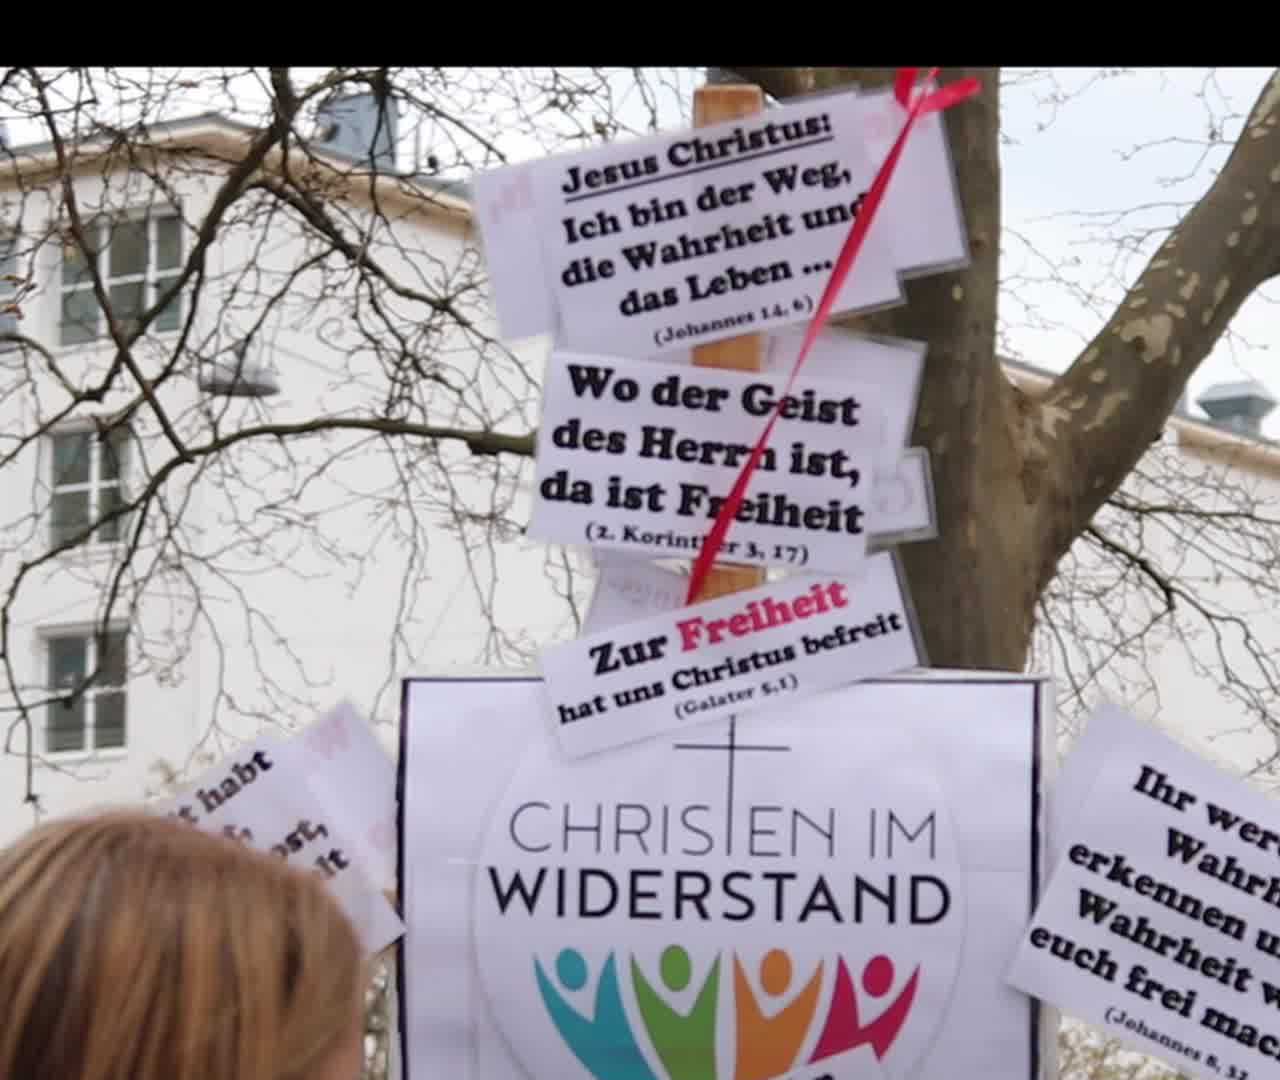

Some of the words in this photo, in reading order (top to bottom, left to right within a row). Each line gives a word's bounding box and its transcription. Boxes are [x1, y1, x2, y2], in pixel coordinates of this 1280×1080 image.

[562, 156, 659, 194] Jesus
[668, 114, 832, 167] Christus:
[563, 212, 621, 243] Ich
[628, 199, 688, 227] bin
[697, 183, 754, 212] der
[763, 162, 851, 194] Weg,
[562, 258, 614, 287] die
[622, 214, 793, 270] Wahrheit
[620, 288, 678, 316] das
[685, 261, 792, 301] Leben
[654, 312, 754, 345] (Johannes
[568, 365, 639, 402] Wo
[652, 376, 729, 412] der
[741, 384, 860, 426] Geist
[552, 419, 626, 454] des
[639, 426, 776, 471] Herrn
[789, 442, 859, 487] ist,
[540, 472, 593, 504] da
[606, 476, 666, 512] ist
[677, 483, 864, 534] Freiheit
[586, 522, 615, 542] (2.
[624, 526, 739, 554] Korintr
[748, 542, 764, 558] 3,
[774, 545, 808, 564] 17)
[589, 636, 667, 675] Zur
[676, 582, 847, 651] Freiheit
[558, 696, 606, 724] hat
[613, 682, 664, 707] uns
[672, 646, 795, 690] Christus
[801, 614, 901, 654] befreit
[675, 688, 754, 719] (Galater
[197, 752, 272, 808] habt
[1134, 766, 1196, 811] Ihr
[510, 802, 834, 857] CHRISTEN
[870, 809, 935, 860] IM
[489, 867, 950, 924] WIDERSTAND
[1069, 845, 1246, 940] erkennen
[1080, 888, 1253, 992] Wahrheit
[1030, 928, 1117, 981] euch
[1124, 965, 1196, 1017] frei
[1105, 1008, 1200, 1060] (Johannes
